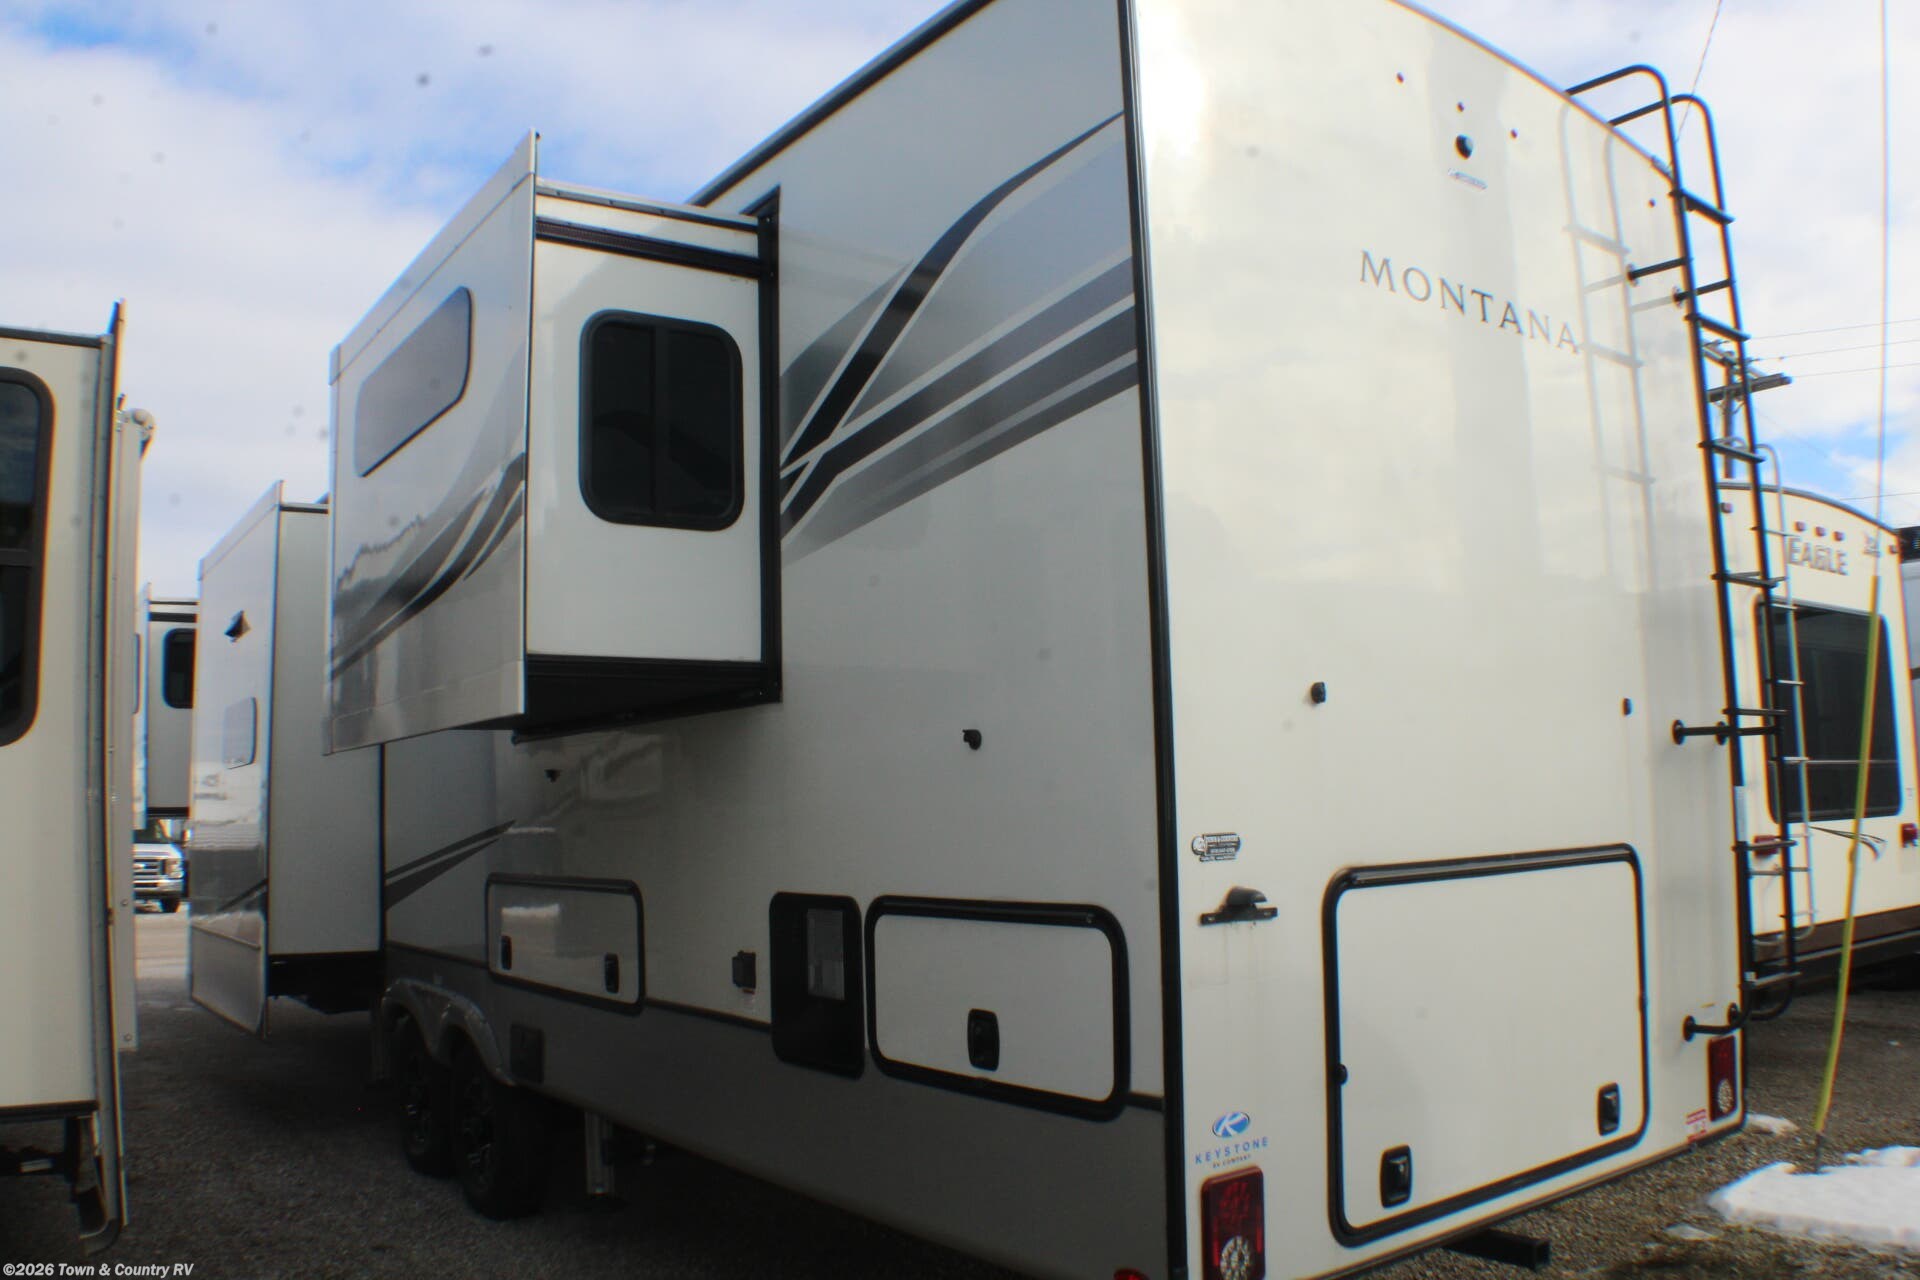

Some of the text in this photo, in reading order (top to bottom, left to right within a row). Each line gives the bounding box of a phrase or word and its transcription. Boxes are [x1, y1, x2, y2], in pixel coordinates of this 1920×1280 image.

[1360, 250, 1579, 354] MONTANA
[1787, 537, 1849, 576] EAGLE
[1195, 1136, 1268, 1164] KEYSTONE
